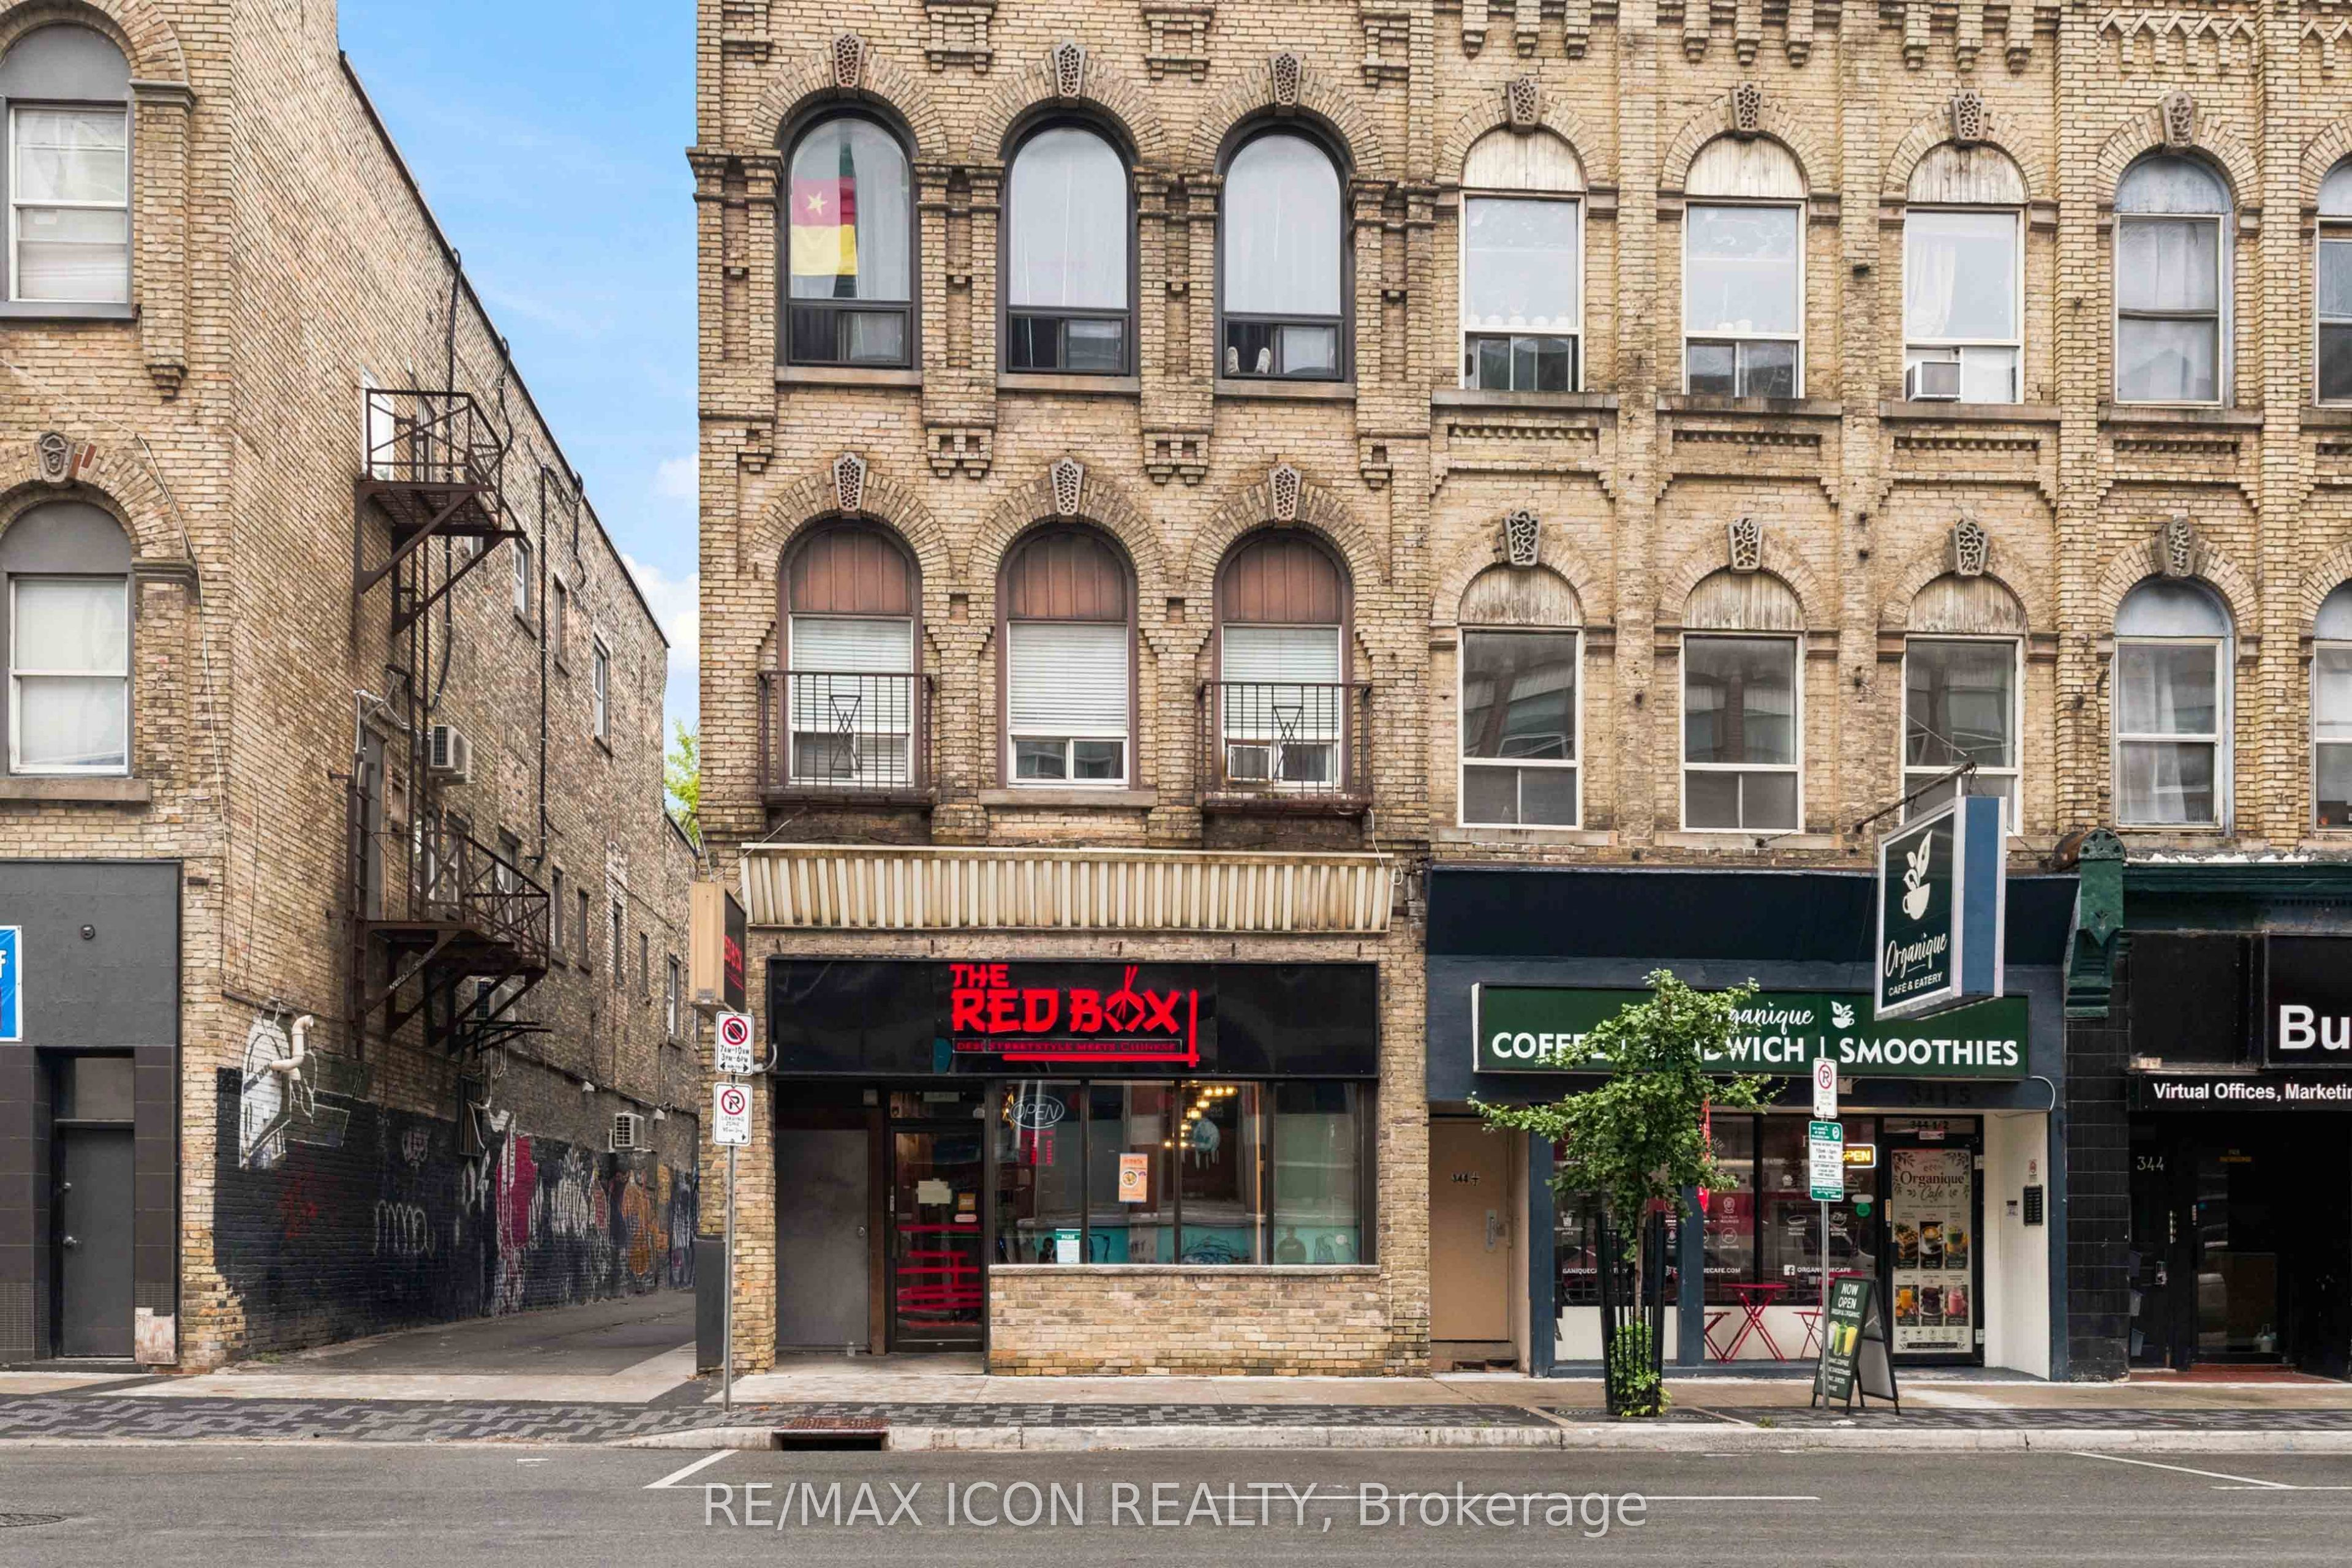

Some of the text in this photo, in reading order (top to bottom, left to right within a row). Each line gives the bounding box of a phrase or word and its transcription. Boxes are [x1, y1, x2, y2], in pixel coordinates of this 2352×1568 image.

[1885, 932, 1948, 978] Organique
[950, 965, 1009, 987] THE
[1907, 981, 1913, 990] &
[1915, 971, 1943, 990] EATERY
[951, 978, 1182, 1035] RED BOX
[2279, 1005, 2351, 1050] Bu
[1077, 1042, 1115, 1051] MEETS
[1840, 1038, 2019, 1066] SMOOTHIES
[2153, 1082, 2209, 1099] Virtual
[2214, 1082, 2282, 1102] Offices,
[1013, 1103, 1060, 1120] OPEN
[2137, 1156, 2165, 1171] 344
[1900, 1170, 1964, 1188] Organique
[1841, 1283, 1859, 1296] NOW
[1838, 1296, 1857, 1310] OPEN
